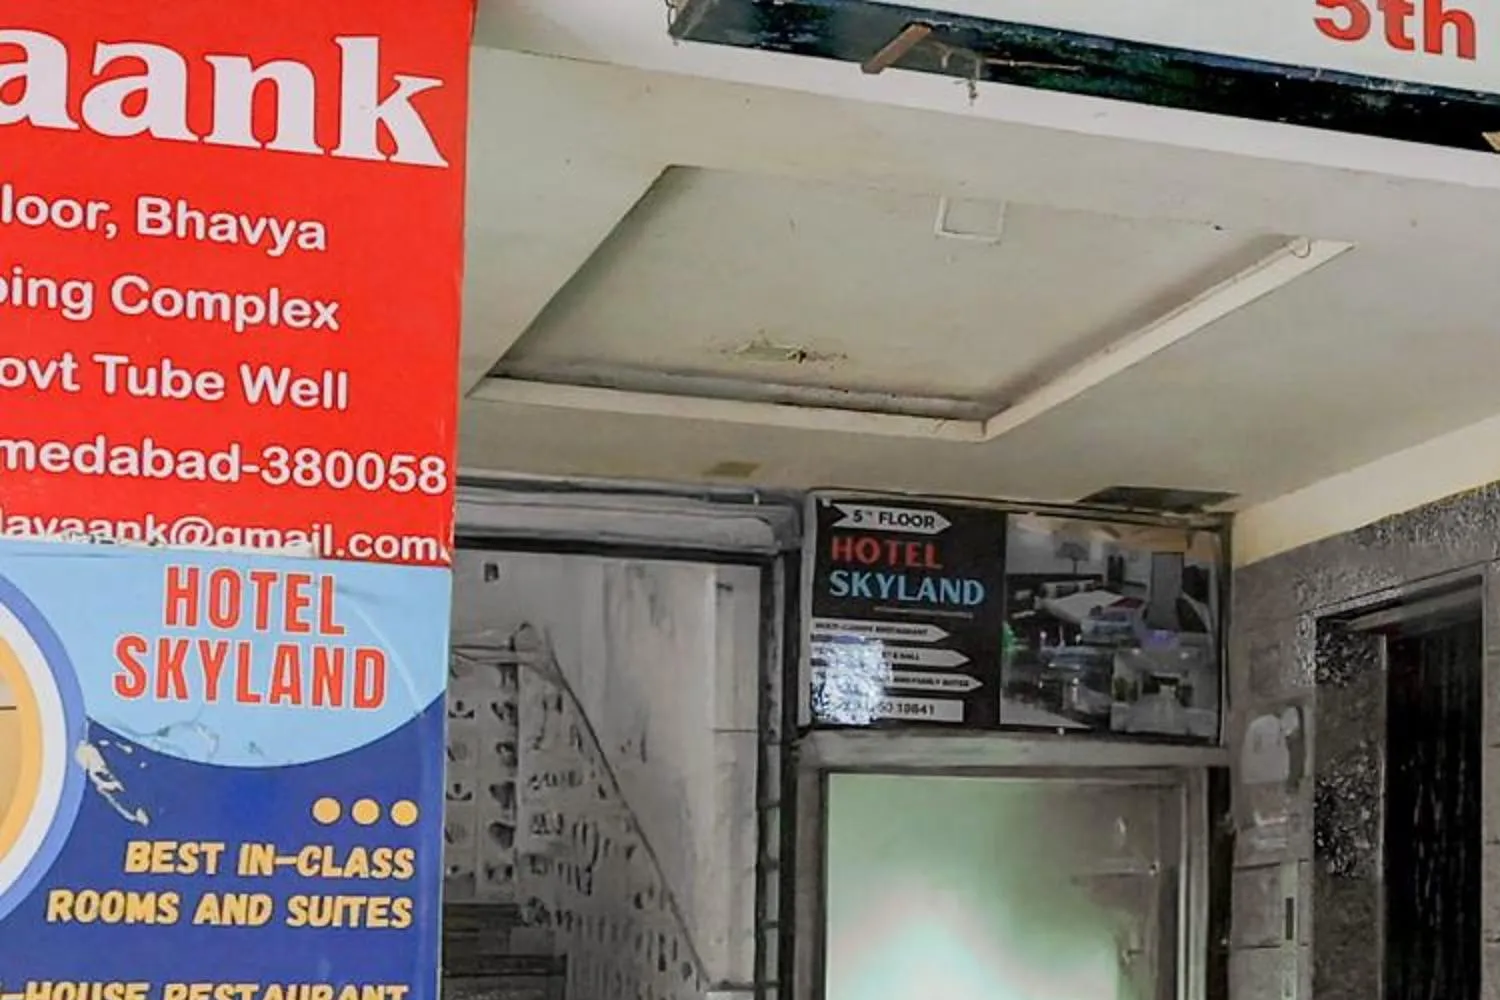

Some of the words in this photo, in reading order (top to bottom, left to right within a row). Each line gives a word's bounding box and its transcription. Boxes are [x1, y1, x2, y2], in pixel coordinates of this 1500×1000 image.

[1313, 0, 1476, 60] 5th
[136, 195, 327, 257] Bhavya
[111, 274, 340, 334] Complex
[93, 353, 226, 401] Tube
[240, 363, 348, 411] Well
[879, 510, 936, 530] FLOOR
[831, 536, 943, 568] HOTEL
[163, 564, 347, 637] HOTEL
[829, 570, 985, 605] SKYLAND
[112, 634, 388, 711] SKYLAND
[125, 841, 225, 875] BEST
[237, 843, 416, 880] IN-CLASS
[46, 890, 180, 925] ROOMS
[193, 892, 273, 926] AND
[286, 895, 414, 929] SUITES
